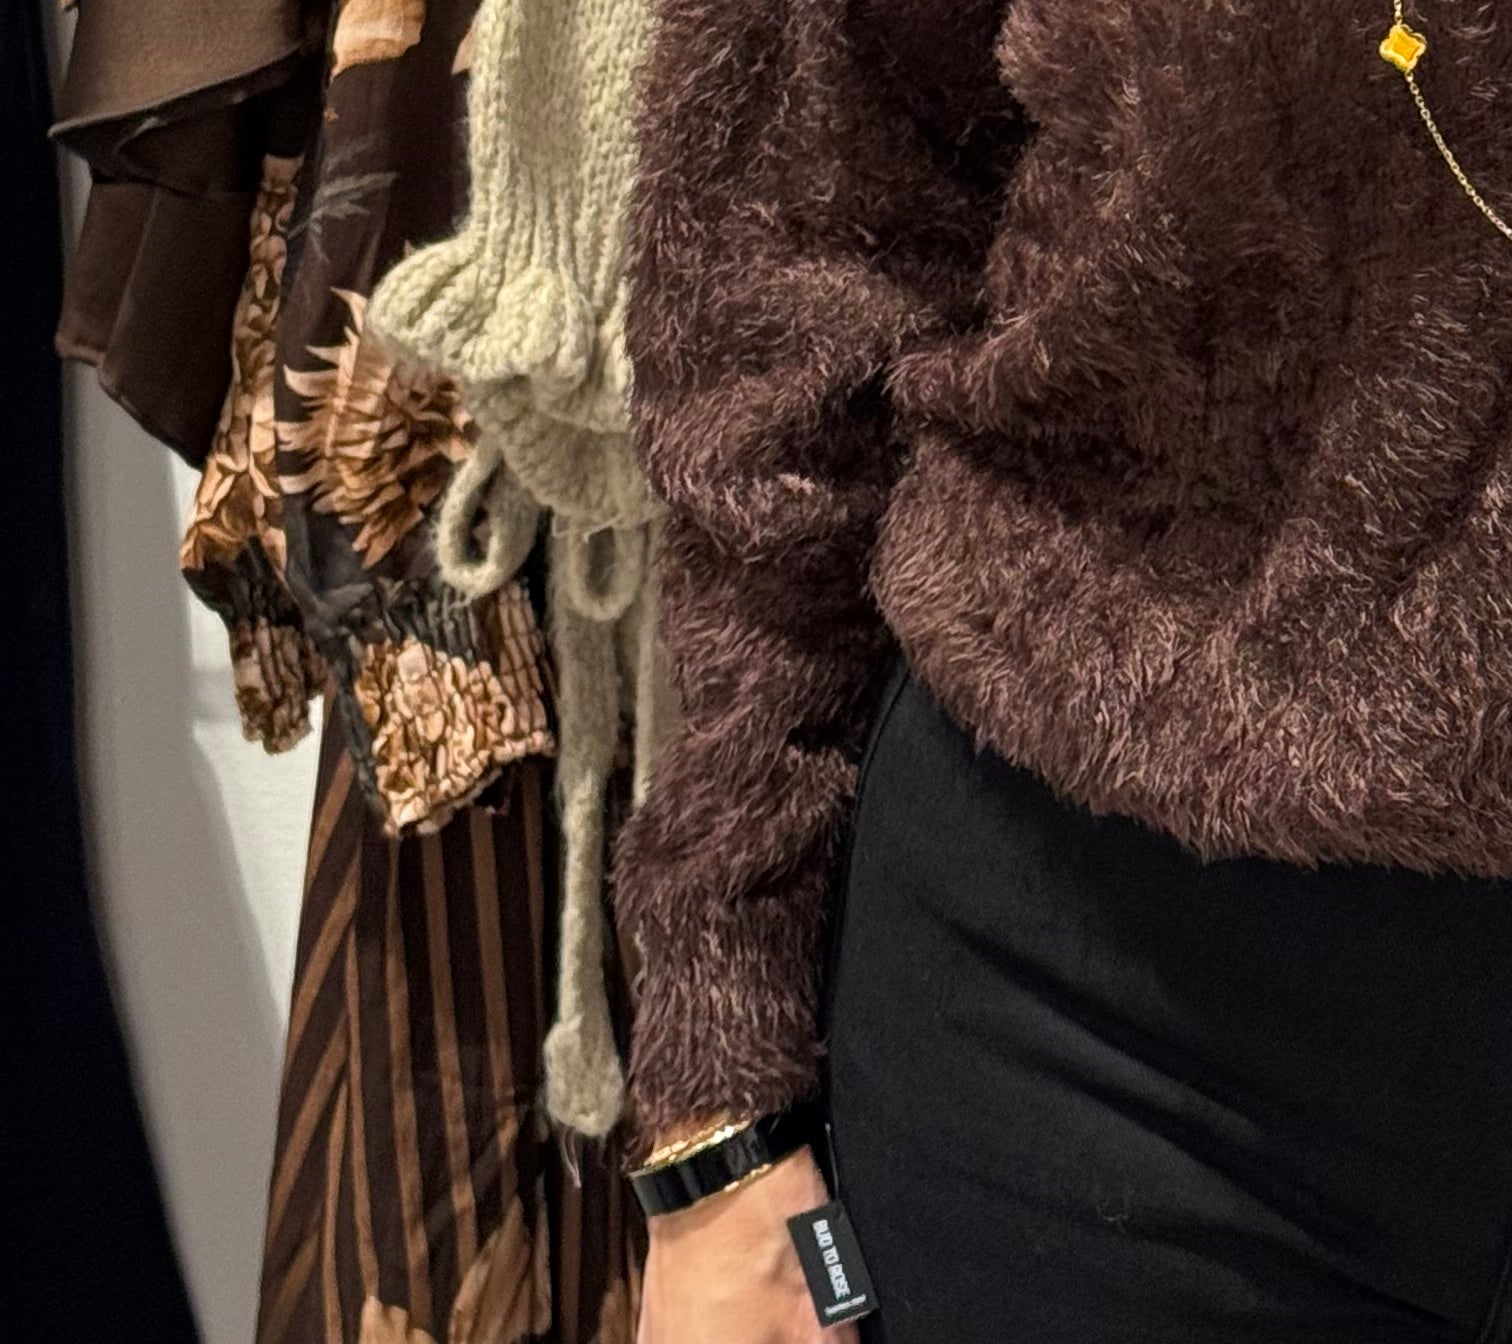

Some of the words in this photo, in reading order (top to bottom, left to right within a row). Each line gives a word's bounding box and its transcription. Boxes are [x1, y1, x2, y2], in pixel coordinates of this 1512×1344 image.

[812, 1219, 834, 1250] BUD
[822, 1244, 840, 1267] TO
[828, 1263, 852, 1301] ROSE
